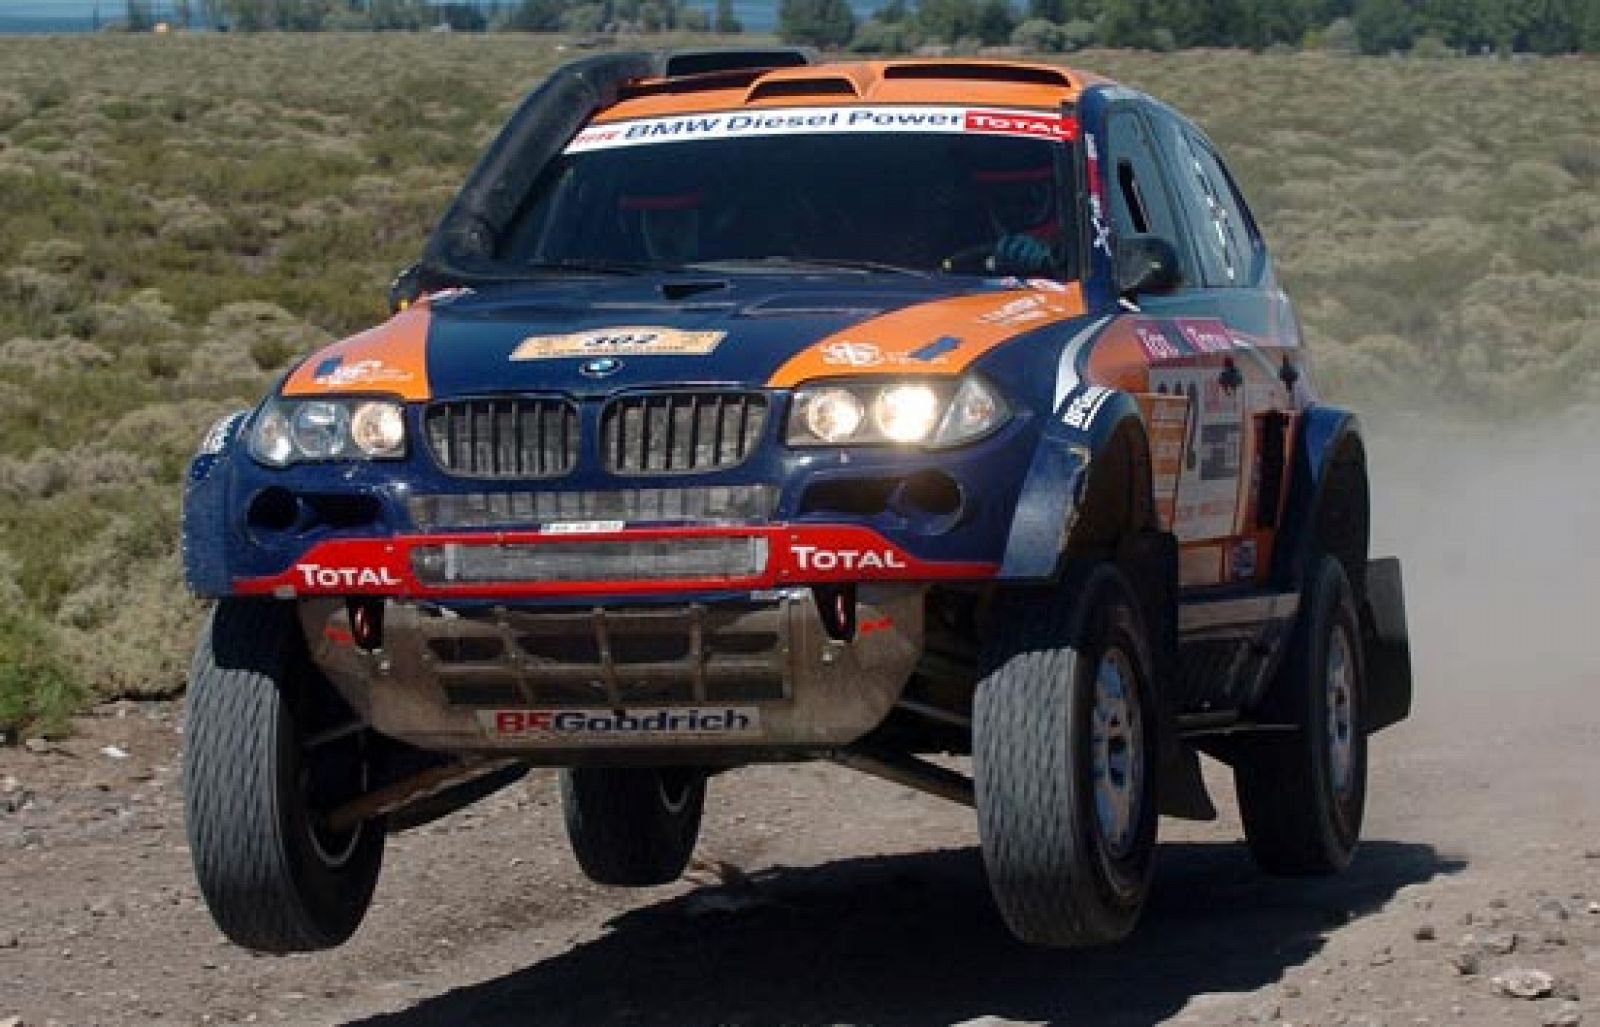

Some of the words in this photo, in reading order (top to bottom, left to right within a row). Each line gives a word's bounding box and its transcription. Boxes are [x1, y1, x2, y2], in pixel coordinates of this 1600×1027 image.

[624, 117, 720, 141] BMW
[726, 112, 839, 130] Diesel
[849, 110, 963, 127] Power
[967, 114, 1072, 136] TOTAL
[790, 544, 907, 570] TOTAL
[296, 563, 402, 587] TOTAL
[495, 708, 750, 732] BFGoodrich
